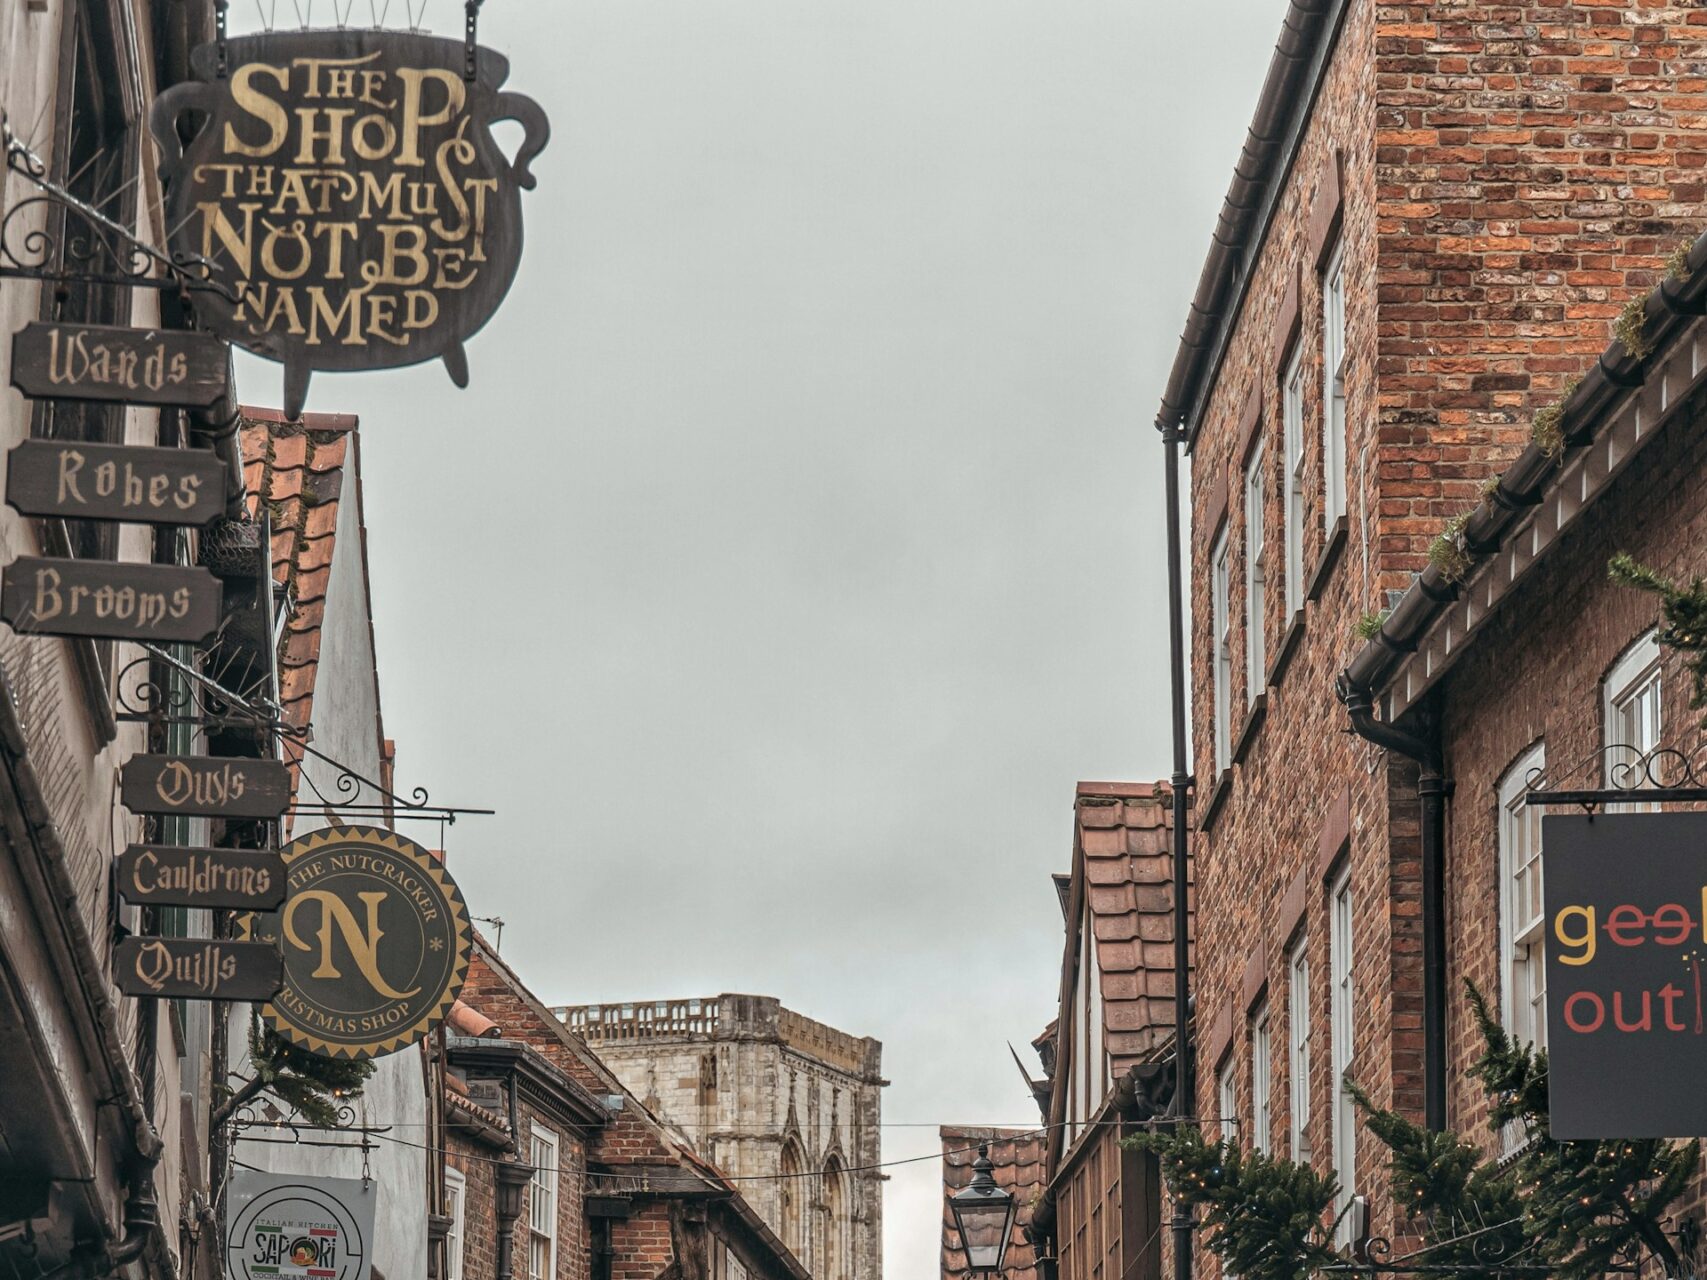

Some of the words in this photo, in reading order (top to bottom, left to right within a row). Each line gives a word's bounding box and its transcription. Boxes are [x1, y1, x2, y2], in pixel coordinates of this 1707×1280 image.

[293, 51, 397, 109] THE
[224, 63, 466, 166] SHOP
[194, 165, 358, 215] THAT
[197, 202, 358, 280] NOT
[361, 224, 478, 290] BE
[233, 281, 439, 345] NAMED
[48, 329, 188, 391] Wands
[58, 450, 203, 509] Robes
[29, 568, 192, 628] Brooms
[156, 761, 246, 807] Owls
[133, 851, 271, 896] Cauldrons
[288, 861, 325, 890] THE
[330, 855, 438, 923] NUTCRACKER
[136, 941, 237, 994] Quills
[282, 890, 422, 999] N
[280, 987, 356, 1033] RISTMAS
[362, 1002, 409, 1032] SHOP
[1564, 983, 1687, 1034] out
[257, 1219, 293, 1227] ITALIAN
[298, 1222, 338, 1230] KITCHEN
[253, 1273, 290, 1280] COCKTAIL
